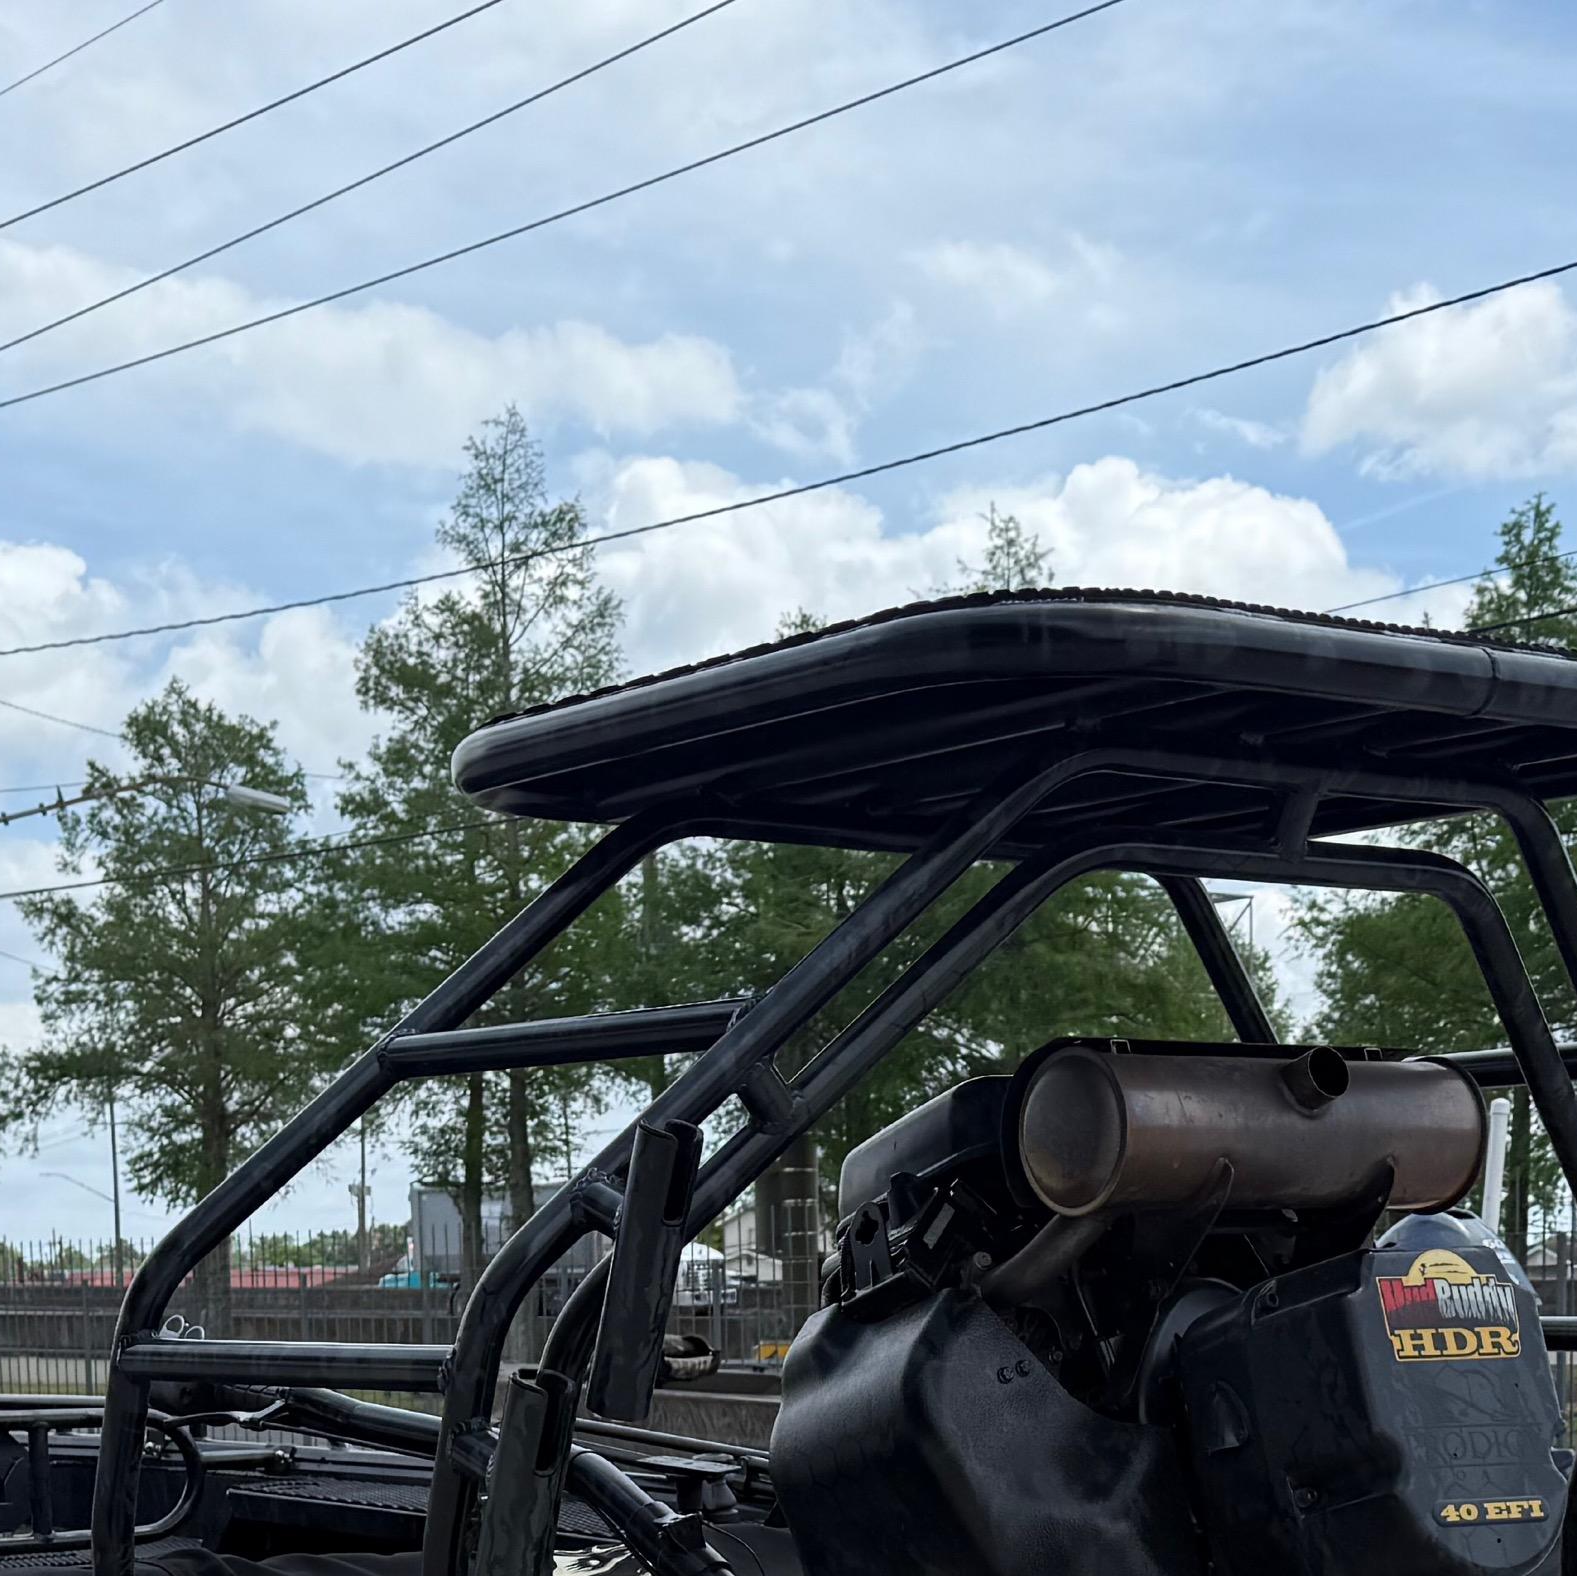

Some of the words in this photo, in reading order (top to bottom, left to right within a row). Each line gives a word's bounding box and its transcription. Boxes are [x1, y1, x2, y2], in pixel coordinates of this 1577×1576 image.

[1394, 1327, 1519, 1357] HDR
[1440, 1503, 1479, 1522] 40
[1484, 1500, 1544, 1520] EFI
